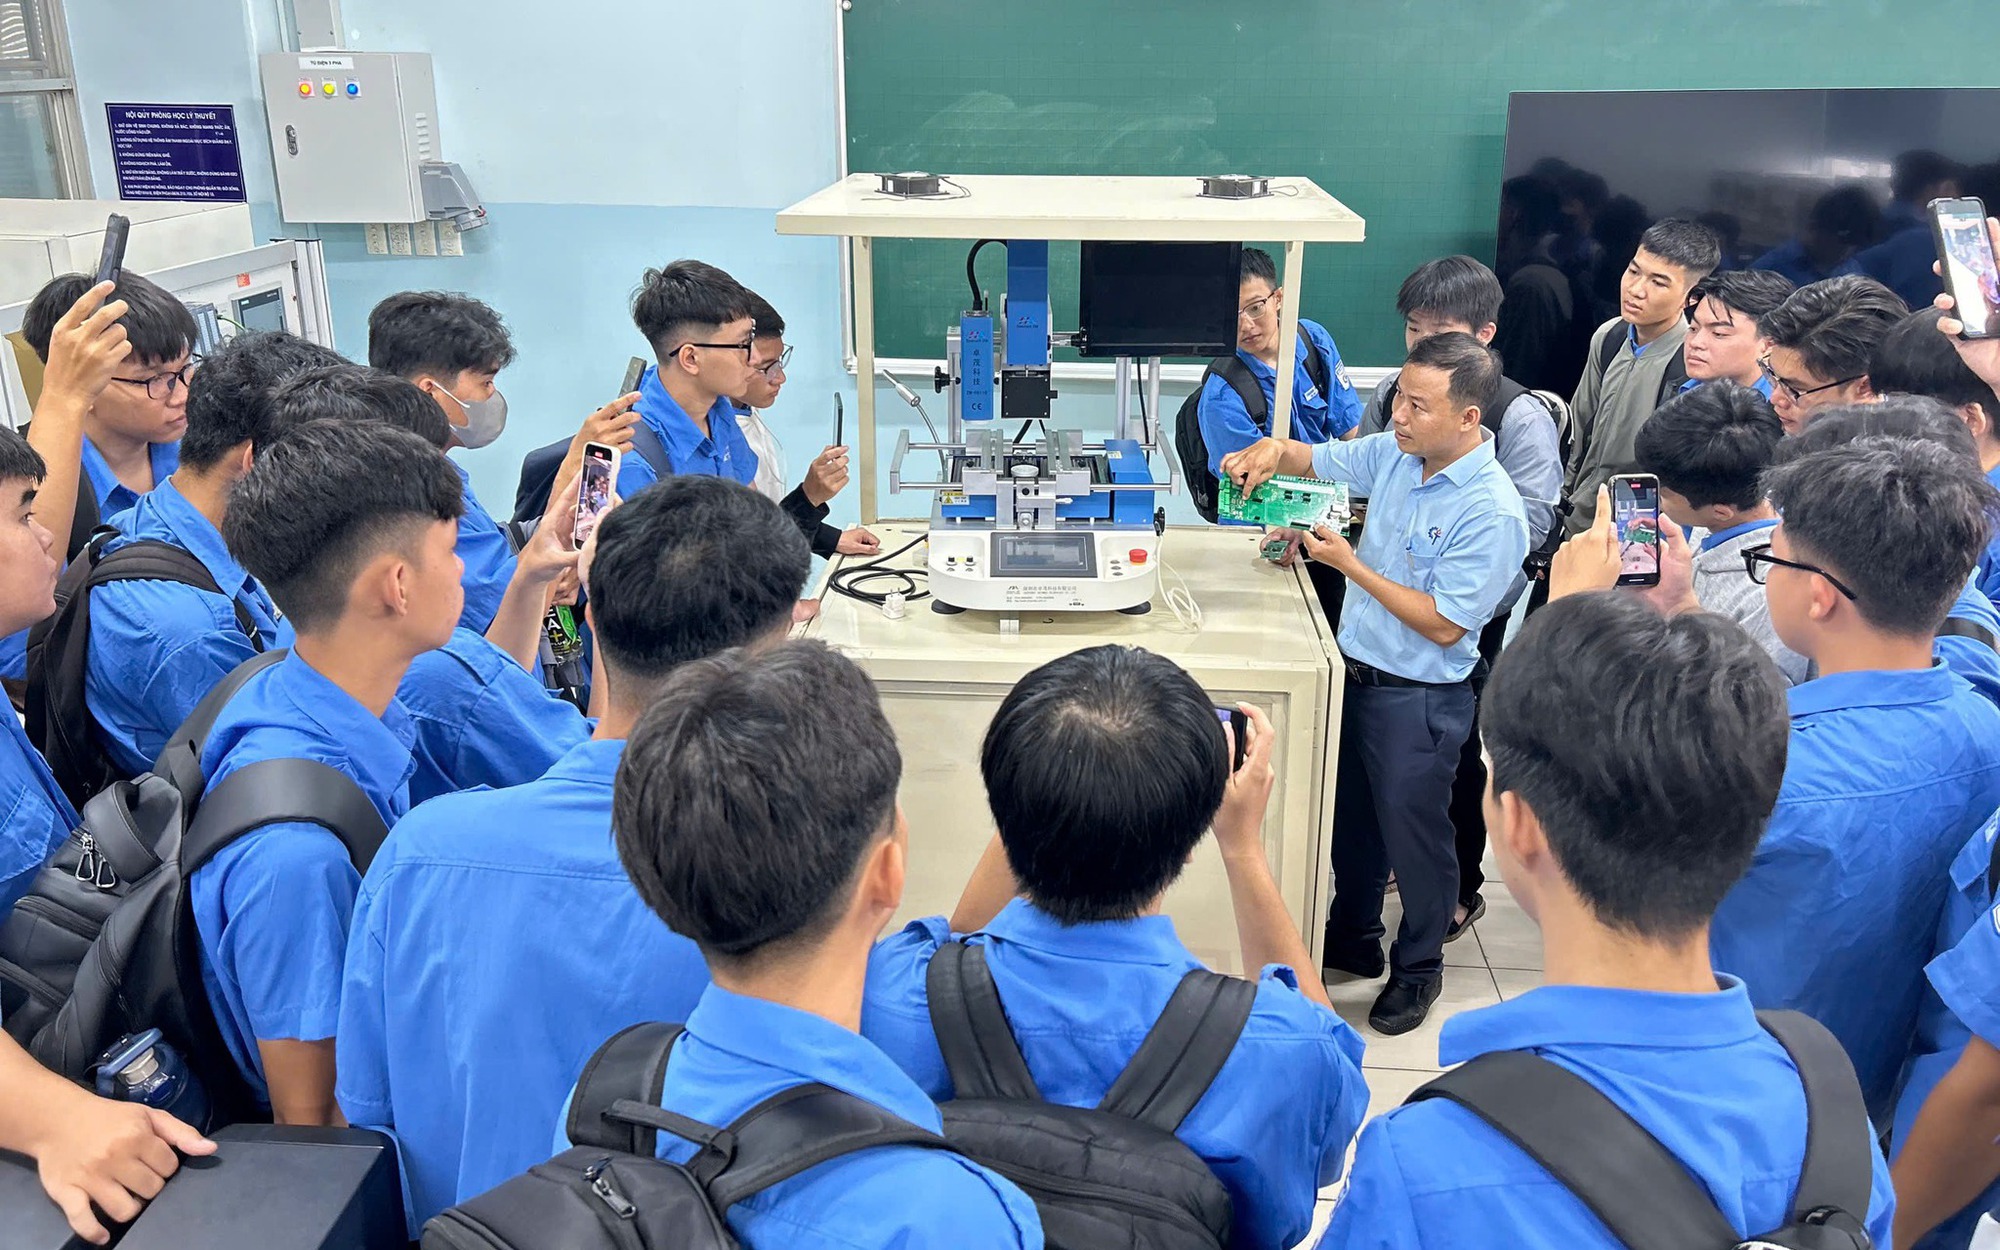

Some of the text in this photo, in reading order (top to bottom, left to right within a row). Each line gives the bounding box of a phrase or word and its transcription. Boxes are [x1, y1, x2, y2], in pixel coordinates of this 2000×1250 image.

[125, 110, 137, 120] NỘI
[151, 111, 172, 119] PHÒNG
[173, 112, 186, 120] HỌC
[194, 111, 216, 120] THUYẾT
